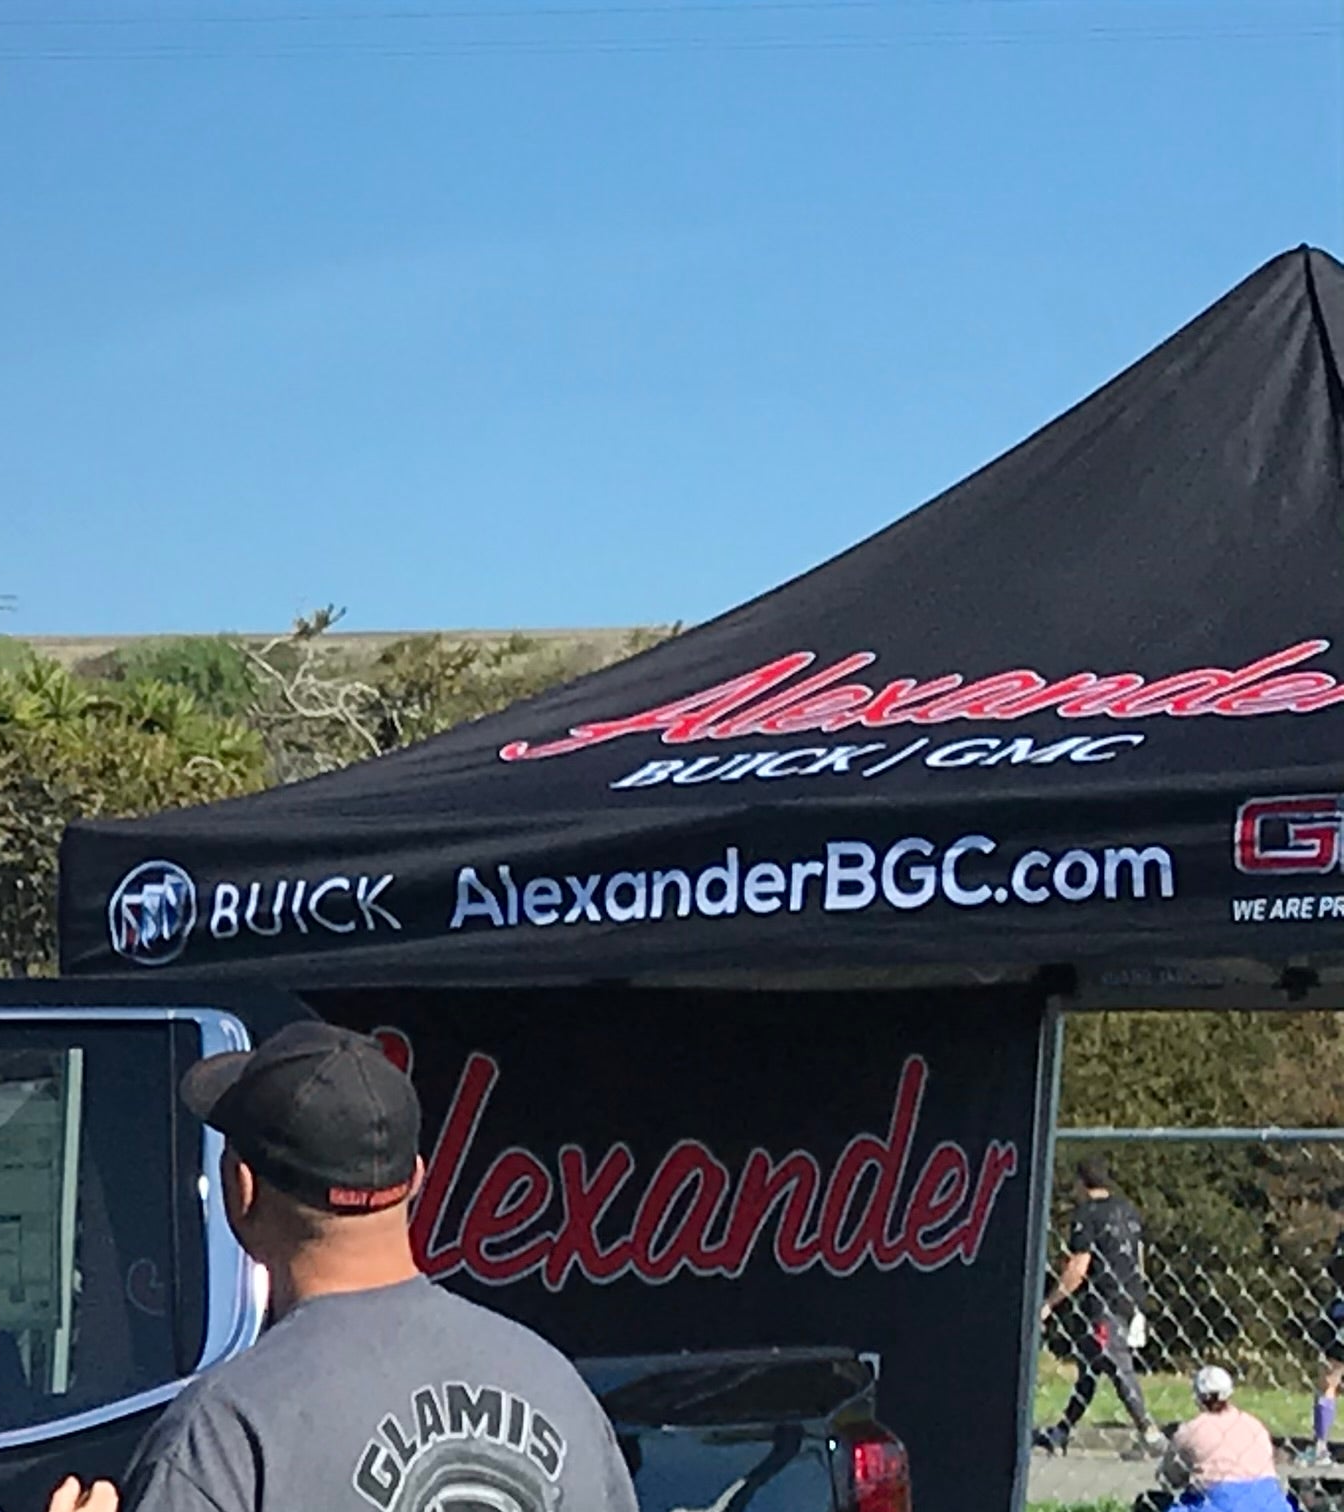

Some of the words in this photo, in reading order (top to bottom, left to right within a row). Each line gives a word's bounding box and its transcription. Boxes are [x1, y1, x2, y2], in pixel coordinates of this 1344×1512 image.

[611, 743, 887, 791] BUICK
[924, 734, 1144, 769] GMC
[1234, 794, 1344, 876] G
[211, 874, 403, 939] BUICK
[450, 835, 1175, 930] AlexanderBGC.com
[1233, 898, 1267, 922] WE
[1269, 896, 1315, 920] ARE
[370, 1029, 1018, 1292] lexander
